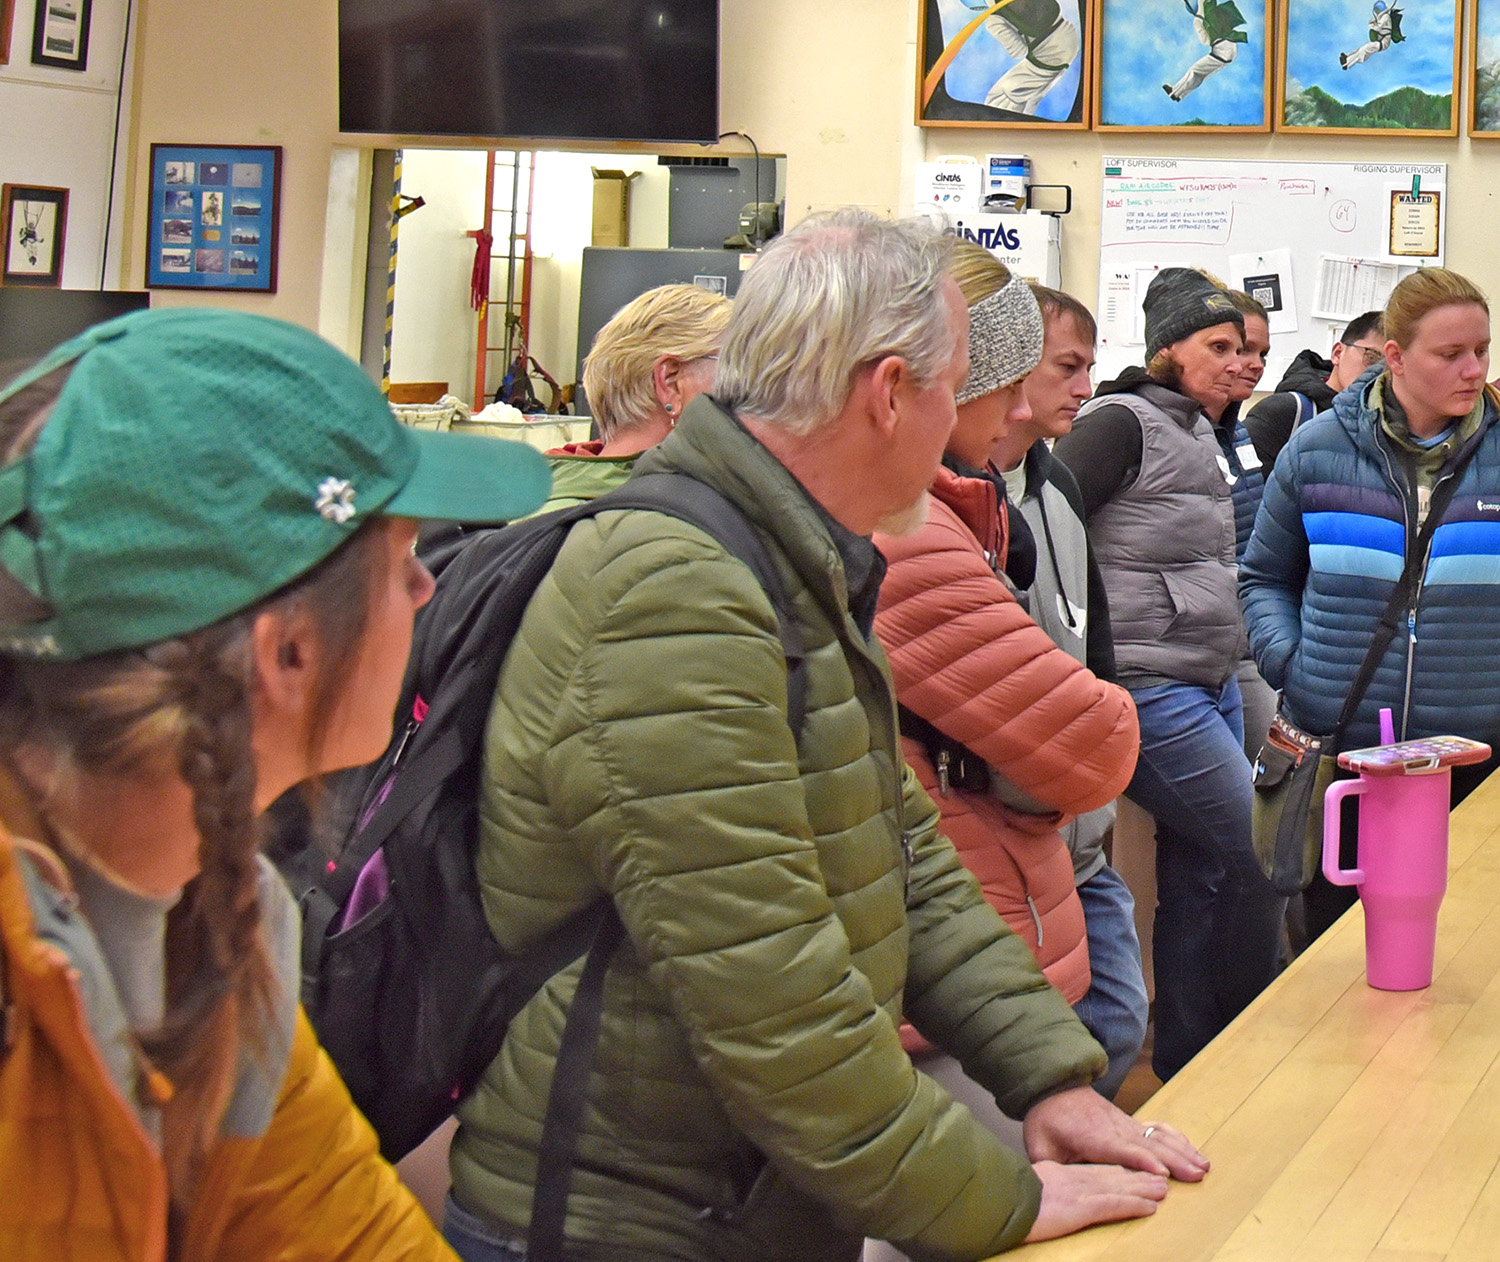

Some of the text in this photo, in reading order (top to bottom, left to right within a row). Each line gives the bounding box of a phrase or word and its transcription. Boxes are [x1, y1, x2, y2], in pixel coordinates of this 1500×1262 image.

[1106, 159, 1177, 169] LOFT SUPERVISOR
[1353, 165, 1441, 174] RIGGING SUPERVISOR
[944, 220, 1021, 251] INTAS
